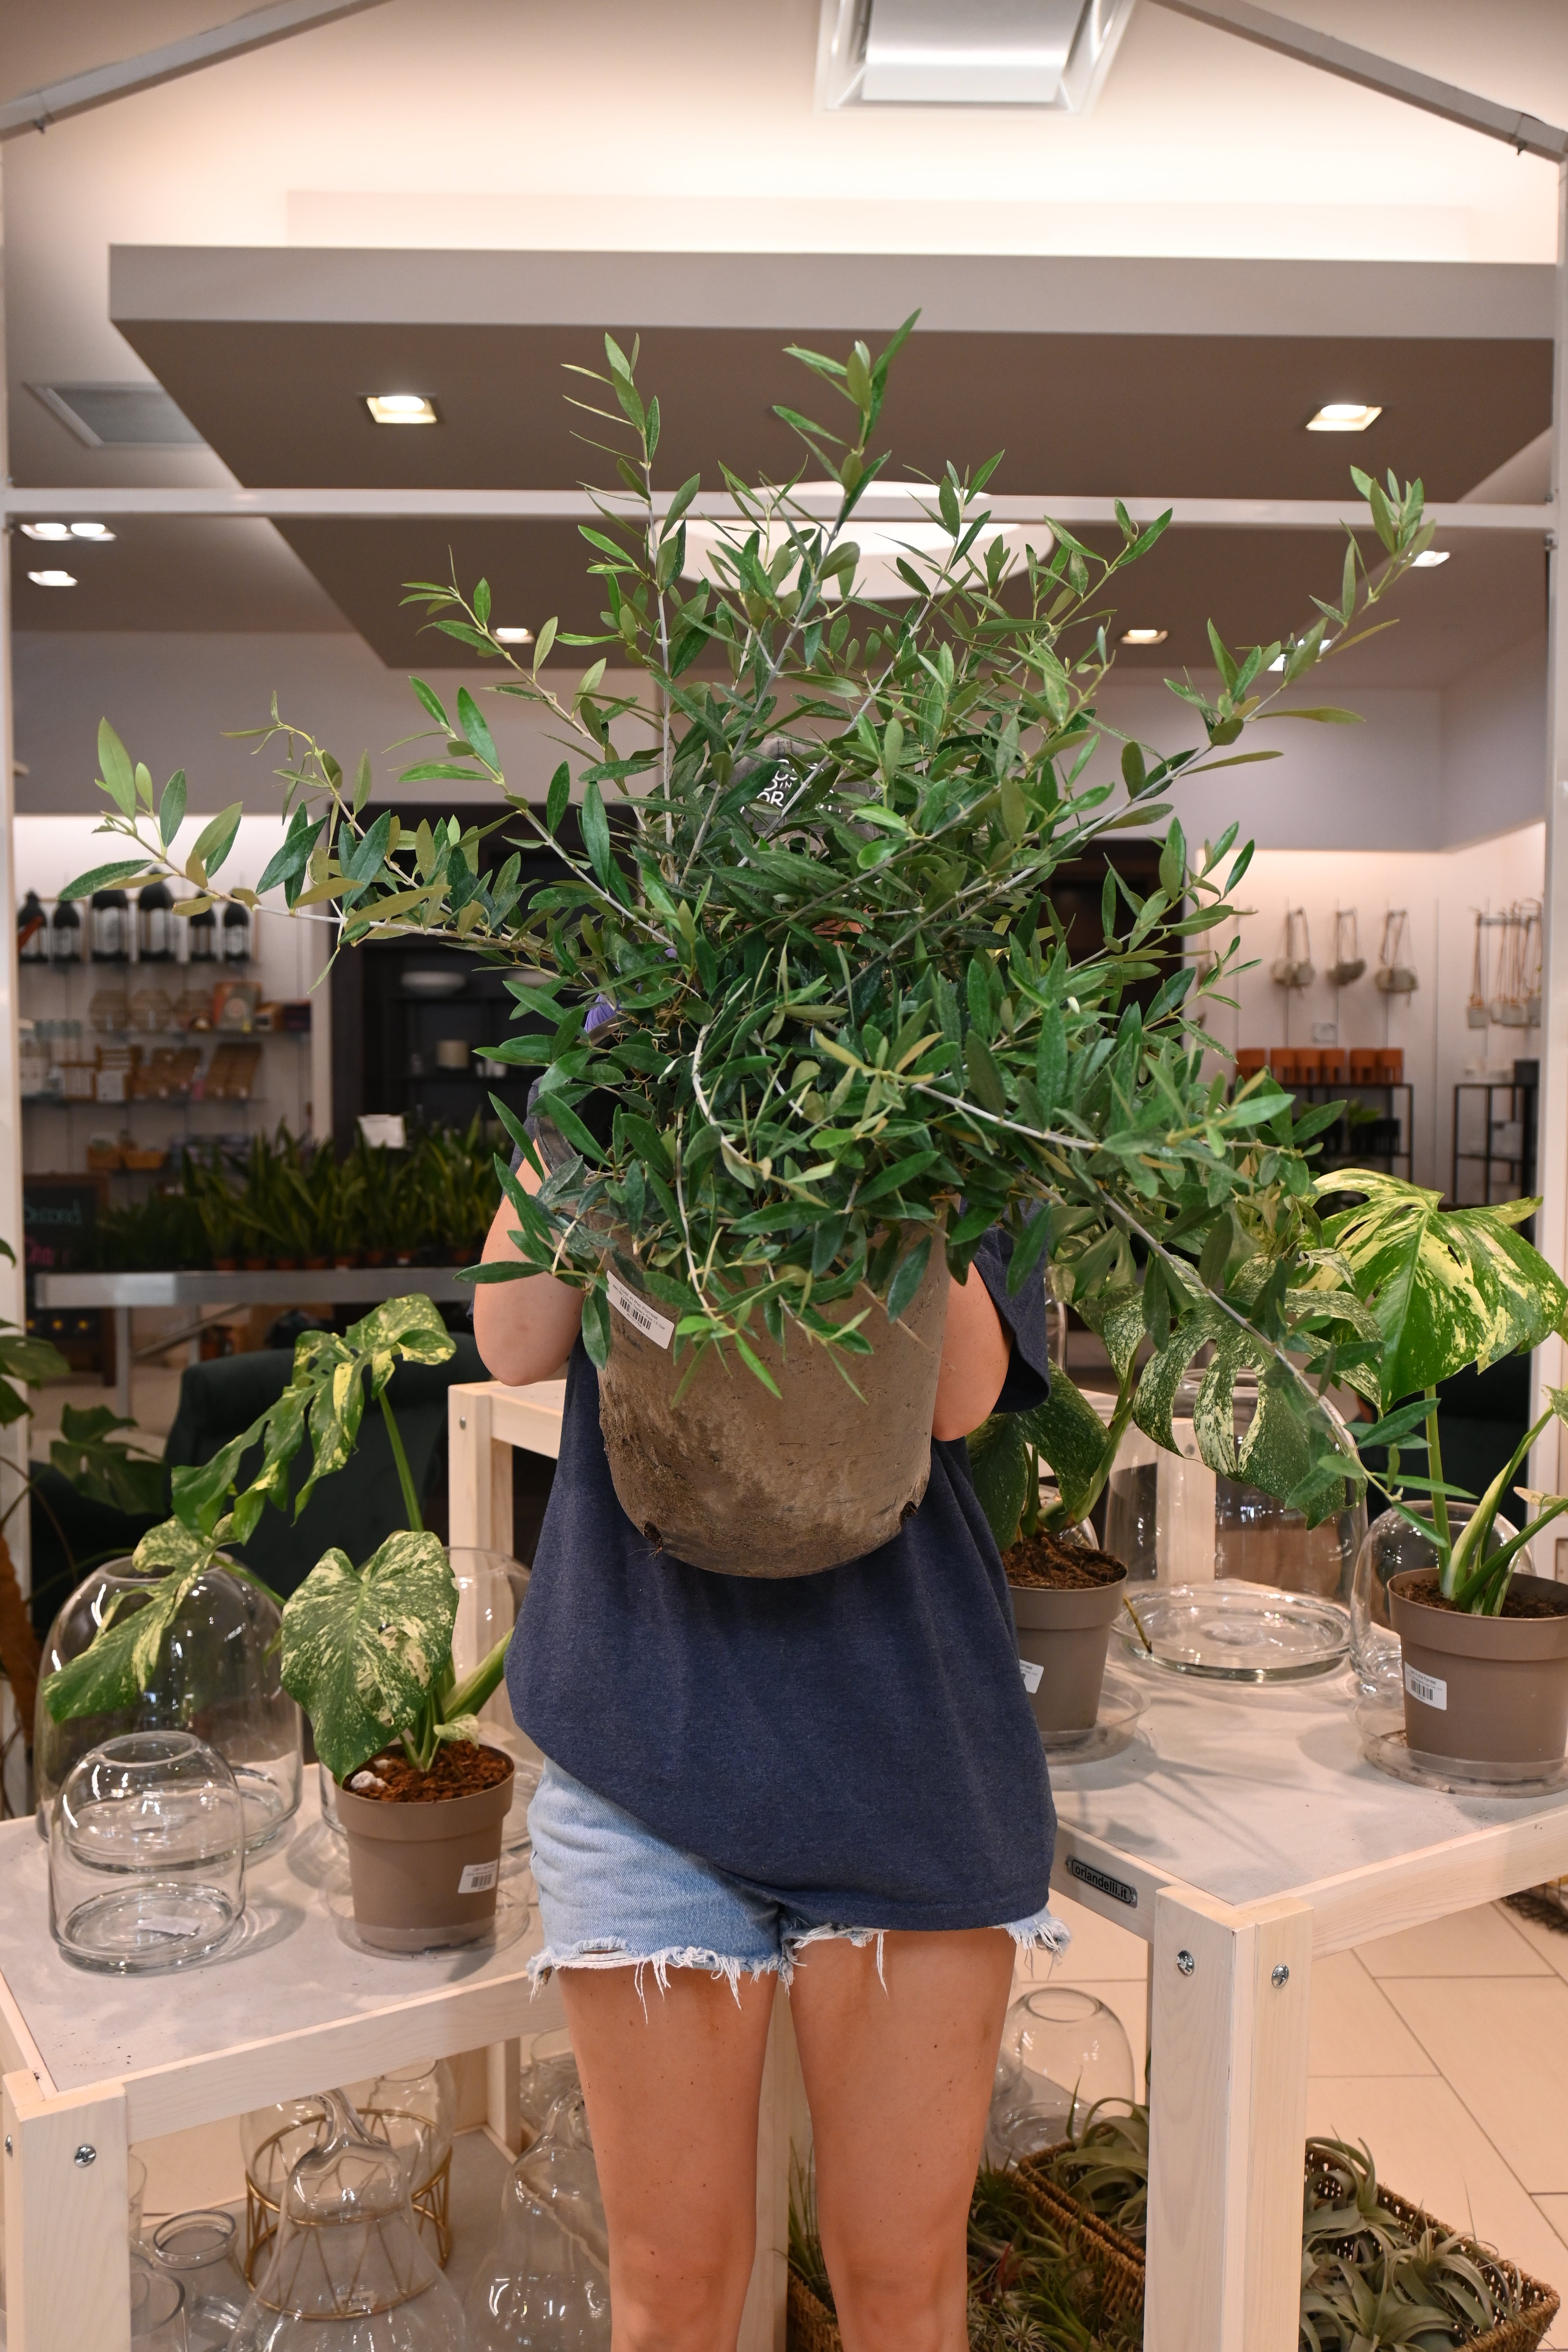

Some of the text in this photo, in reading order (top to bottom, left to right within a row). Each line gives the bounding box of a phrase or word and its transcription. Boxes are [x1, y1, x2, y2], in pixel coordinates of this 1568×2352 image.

[620, 1287, 629, 1296] Lost
[642, 1306, 658, 1320] Forrest
[633, 1304, 645, 1316] Topiary
[1075, 1865, 1127, 1900] orlandelli.it
